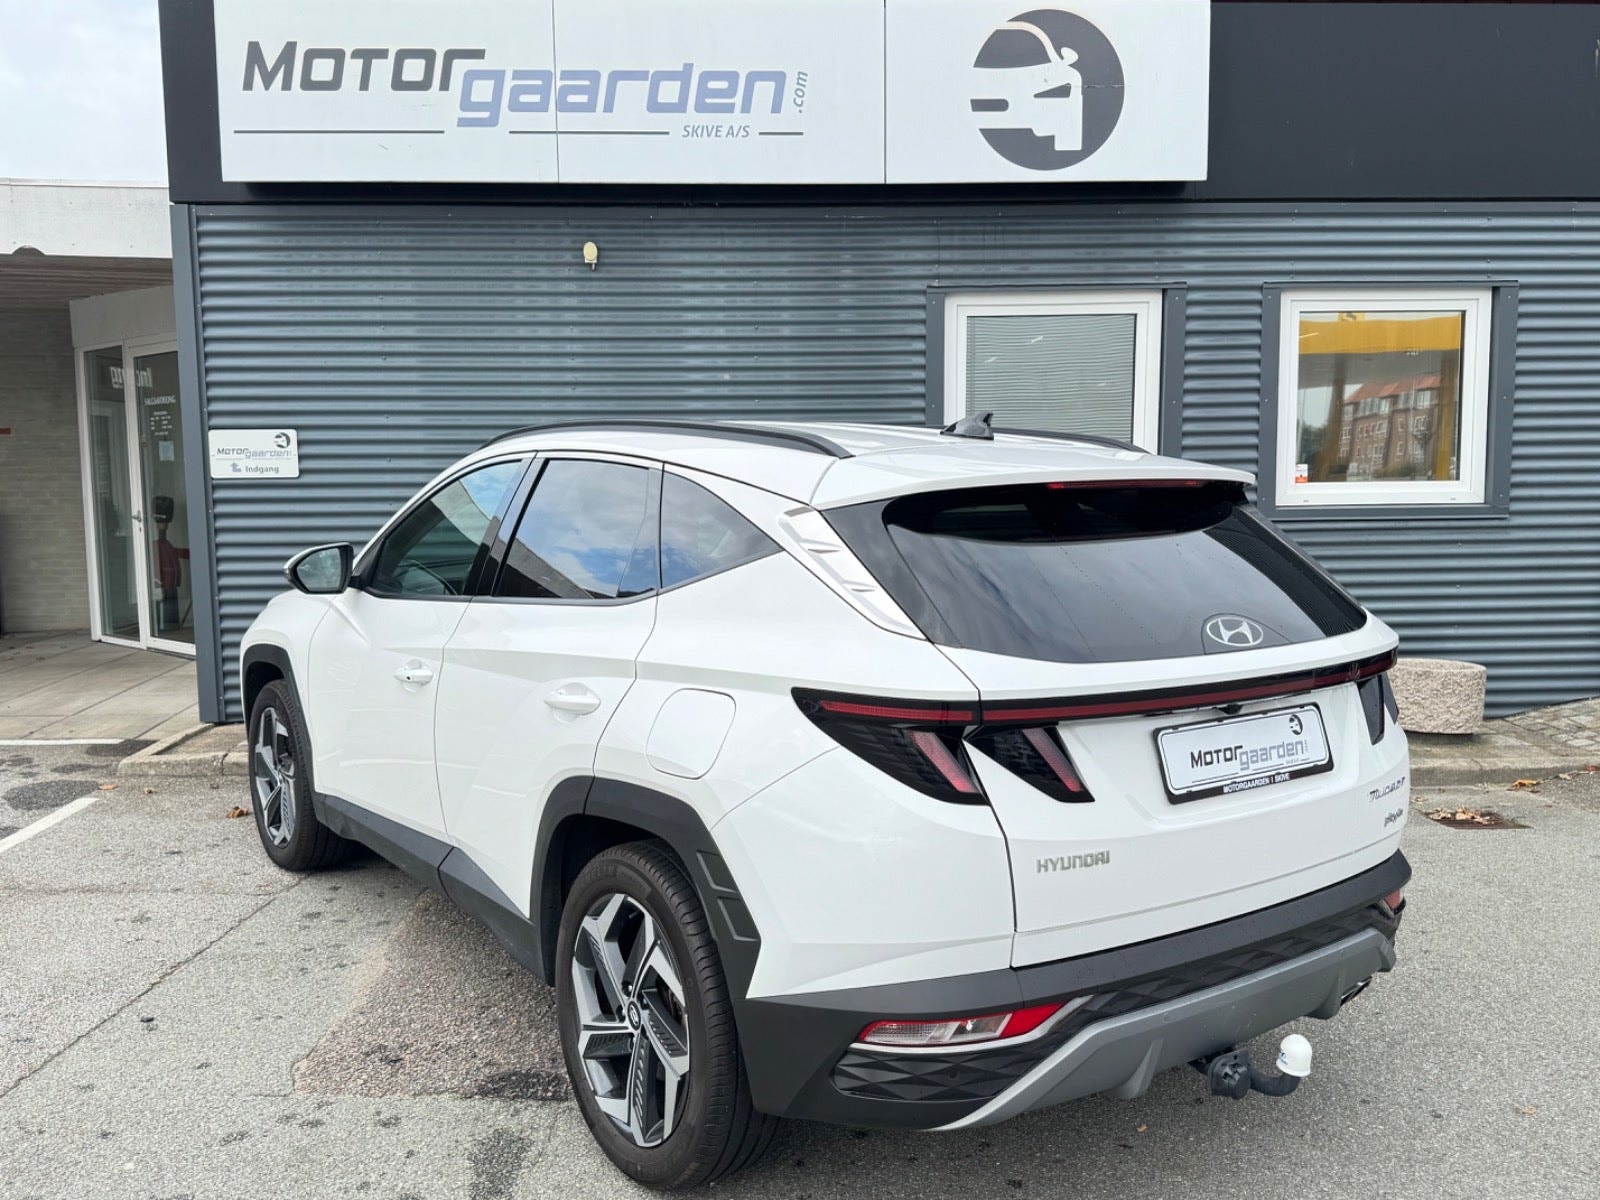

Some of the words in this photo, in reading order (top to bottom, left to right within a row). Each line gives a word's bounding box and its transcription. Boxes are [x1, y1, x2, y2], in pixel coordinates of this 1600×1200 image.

[793, 71, 808, 113] .com
[682, 125, 723, 138] SKIVE
[726, 125, 750, 138] A/S
[245, 466, 279, 474] Indgang
[1223, 778, 1270, 793] MOTORGAARDEN
[1274, 773, 1291, 783] SKIVE
[1036, 850, 1110, 873] HYUNDAI
